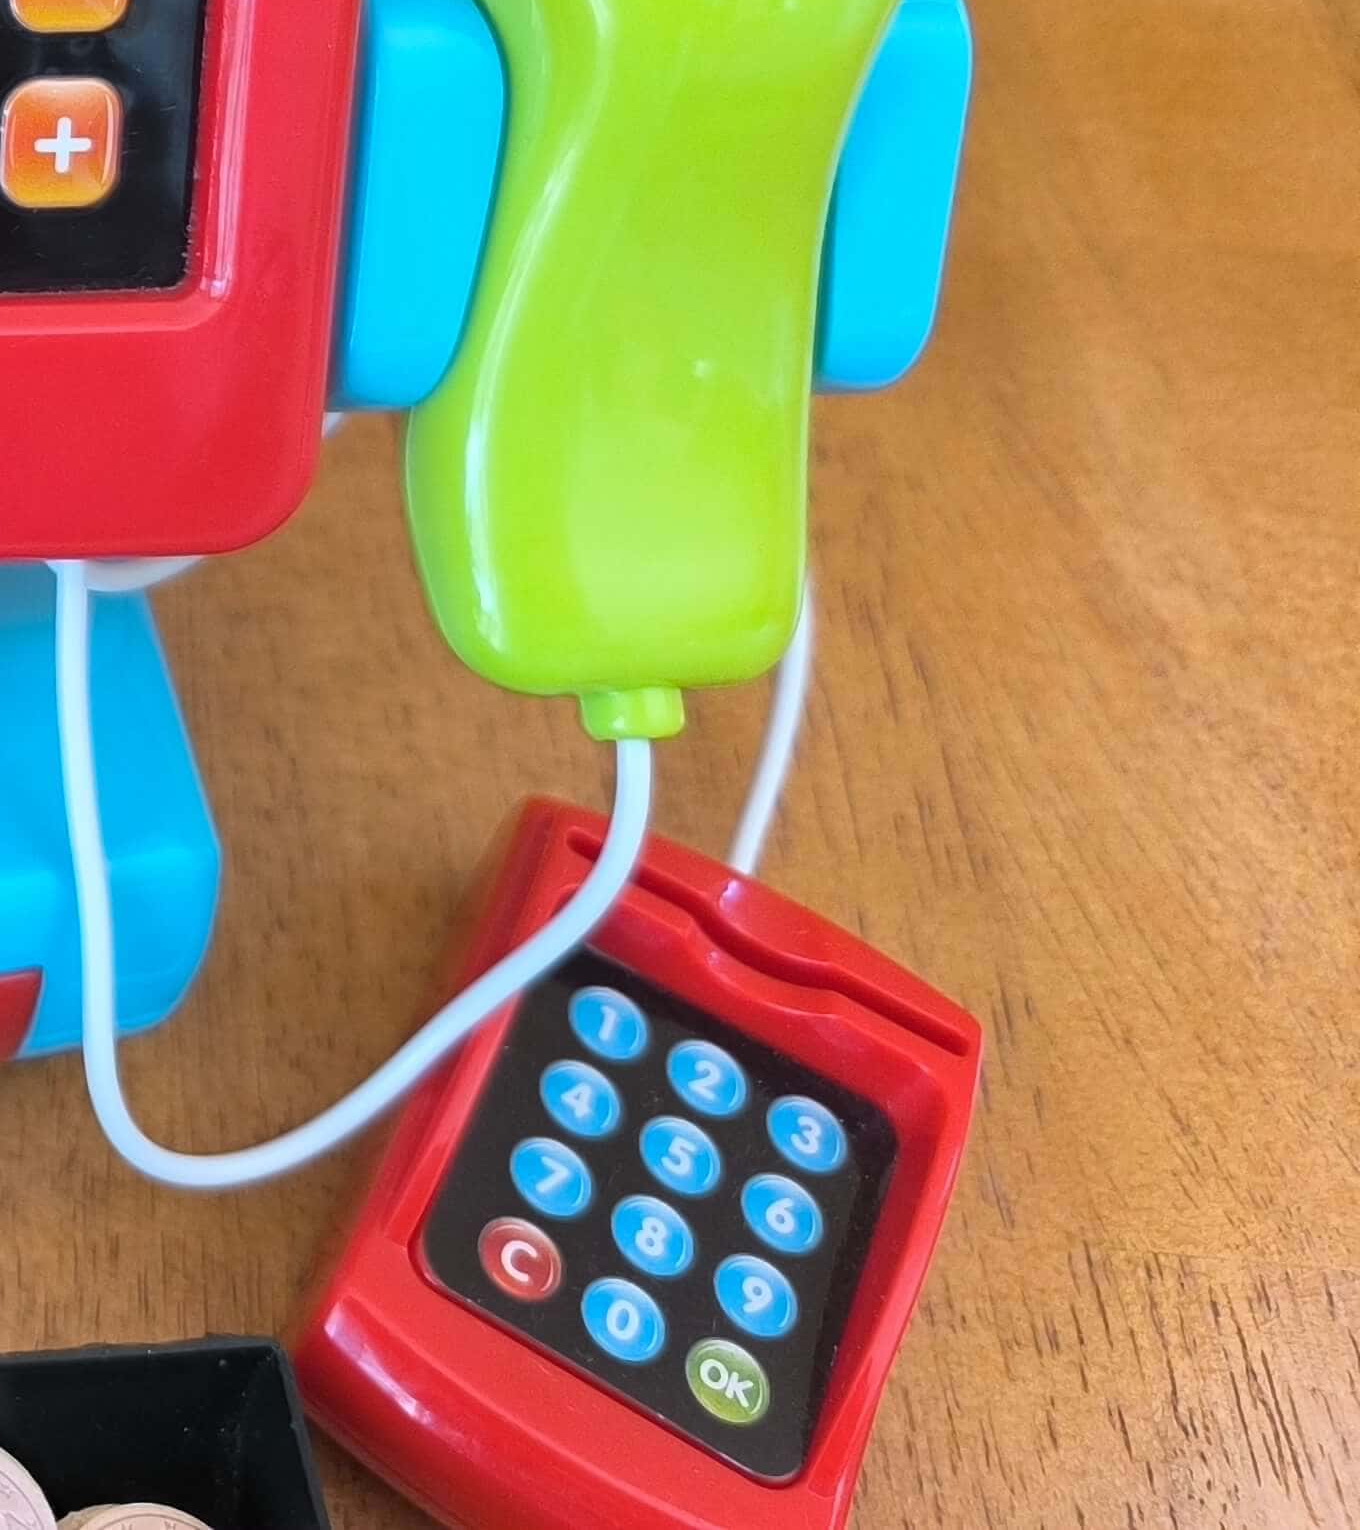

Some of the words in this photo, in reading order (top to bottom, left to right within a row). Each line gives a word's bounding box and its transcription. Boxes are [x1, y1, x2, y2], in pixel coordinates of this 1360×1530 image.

[597, 1005, 618, 1041] 1
[688, 1059, 718, 1102] 2
[559, 1084, 594, 1119] 4
[789, 1114, 822, 1155] 3
[533, 1154, 571, 1195] 7
[660, 1135, 699, 1176] 5
[765, 1196, 796, 1235] 6
[633, 1216, 669, 1258] 8
[499, 1239, 540, 1284] C
[740, 1275, 775, 1314] 9
[605, 1299, 641, 1340] 0
[697, 1356, 756, 1409] OK
